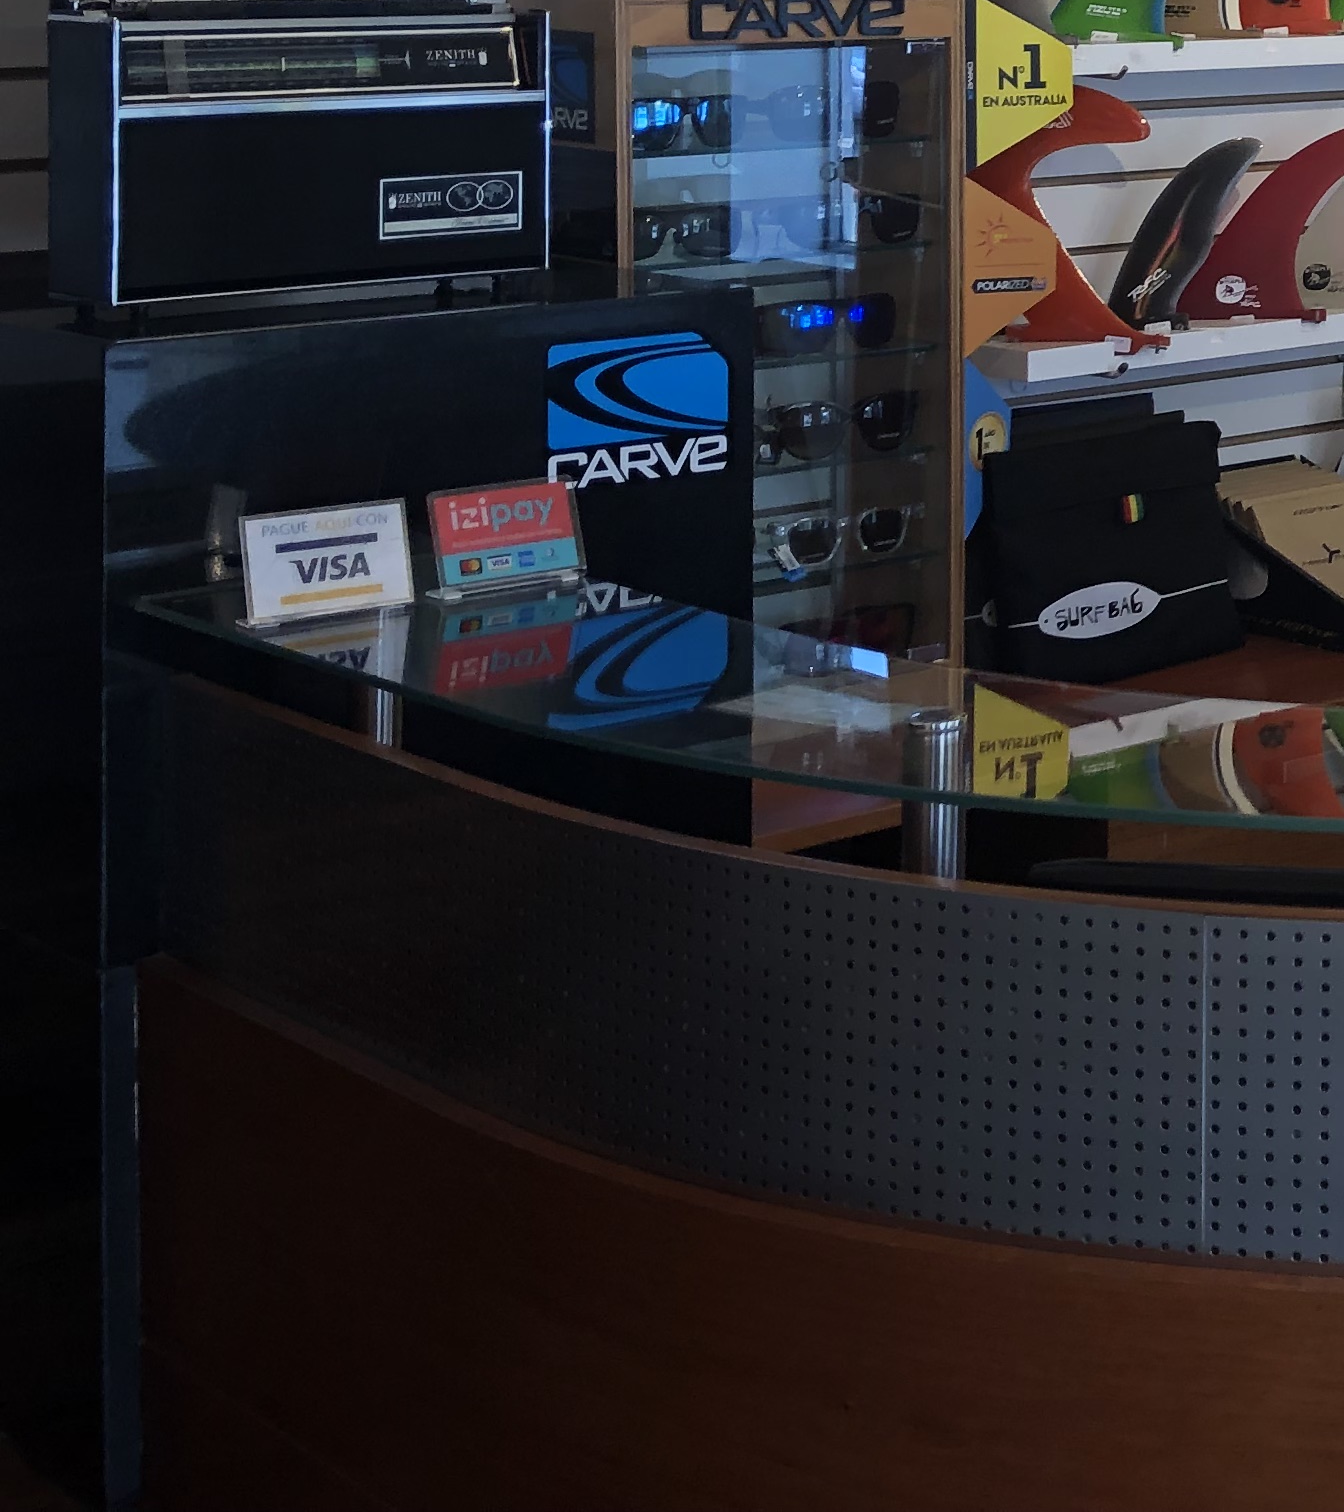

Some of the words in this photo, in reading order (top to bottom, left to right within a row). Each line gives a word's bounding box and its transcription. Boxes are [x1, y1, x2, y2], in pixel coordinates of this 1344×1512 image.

[425, 49, 476, 61] ZENITH
[982, 95, 1000, 107] EN
[1001, 93, 1067, 107] AUSTRALIA
[554, 106, 588, 131] RVE
[397, 190, 442, 204] ZENITH
[977, 279, 1029, 293] POLARIZED
[547, 434, 728, 489] CARVE
[448, 495, 556, 534] izipay
[261, 521, 309, 538] PAGUE
[355, 512, 389, 529] CON
[289, 552, 372, 585] VISA
[490, 556, 511, 568] VISA
